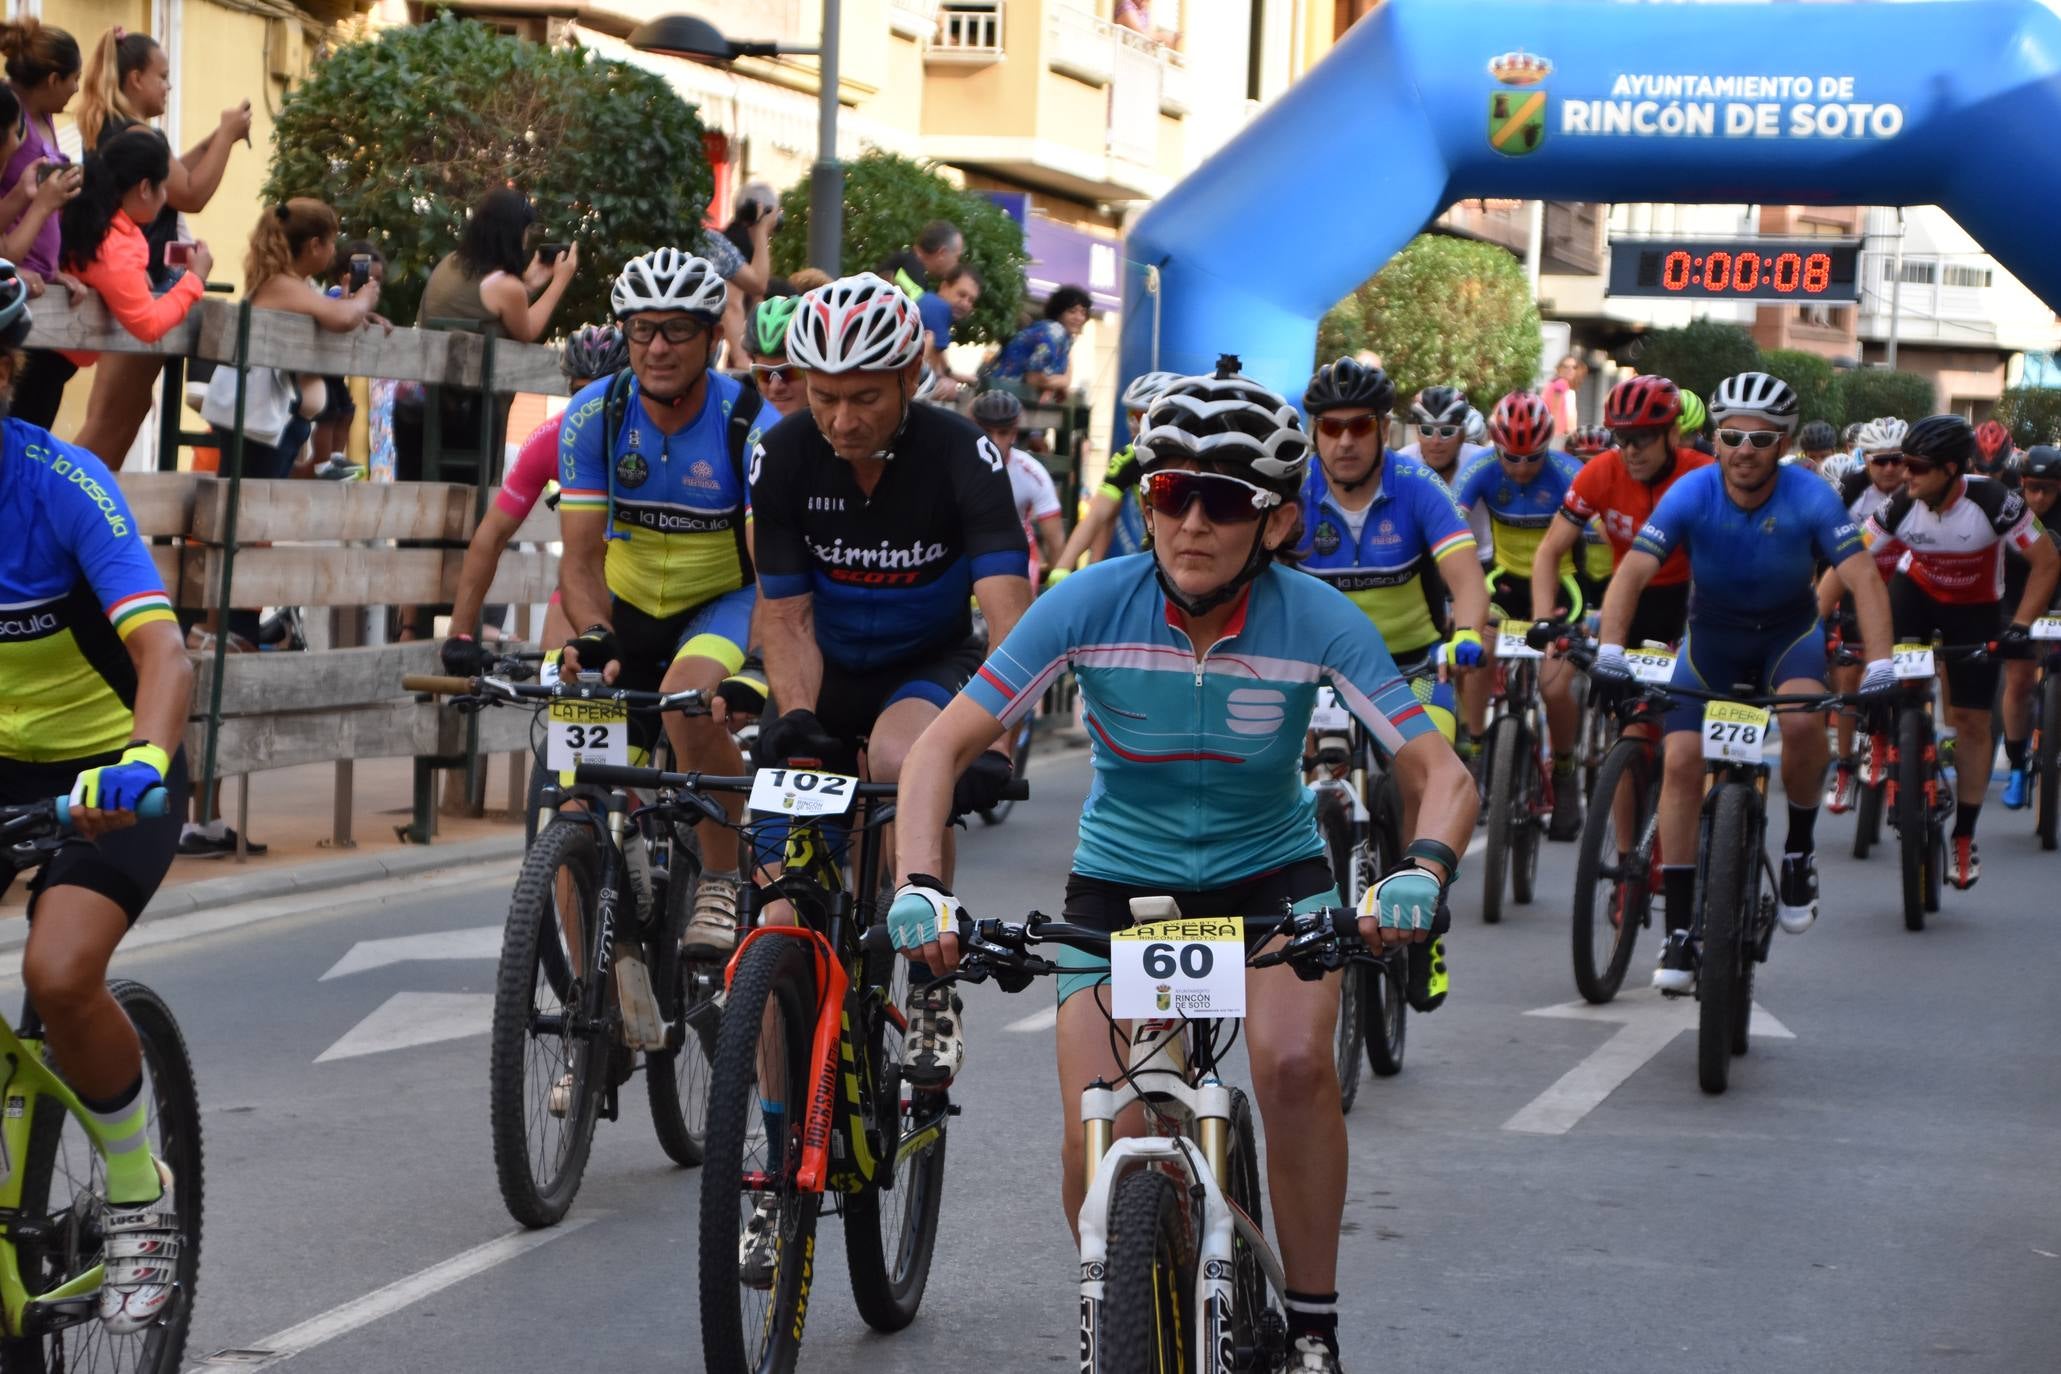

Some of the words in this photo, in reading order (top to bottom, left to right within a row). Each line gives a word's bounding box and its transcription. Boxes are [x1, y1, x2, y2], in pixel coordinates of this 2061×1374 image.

[1611, 73, 1813, 99] AYUNTAMIENTO
[1819, 76, 1855, 99] DE
[1562, 98, 1715, 136] RINCÓN
[1724, 102, 1781, 136] DE
[1789, 103, 1904, 139] SOTO
[1663, 250, 1832, 293] 0:00:08
[51, 454, 73, 475] la
[68, 466, 129, 539] bascula
[808, 497, 846, 511] GOBIK
[639, 507, 654, 524] la
[658, 511, 730, 531] bascula
[829, 568, 921, 584] SCOTT
[0, 613, 57, 636] scula
[1627, 654, 1670, 667] 268
[565, 724, 609, 749] 32
[1710, 722, 1757, 744] 278
[770, 770, 847, 796] 102
[1119, 926, 1155, 937] LA
[1163, 924, 1236, 937] PERA
[1142, 943, 1214, 980] 60
[1175, 993, 1211, 1002] RINCÓN
[1188, 1001, 1211, 1009] SOTO
[110, 1213, 145, 1227] LUCK
